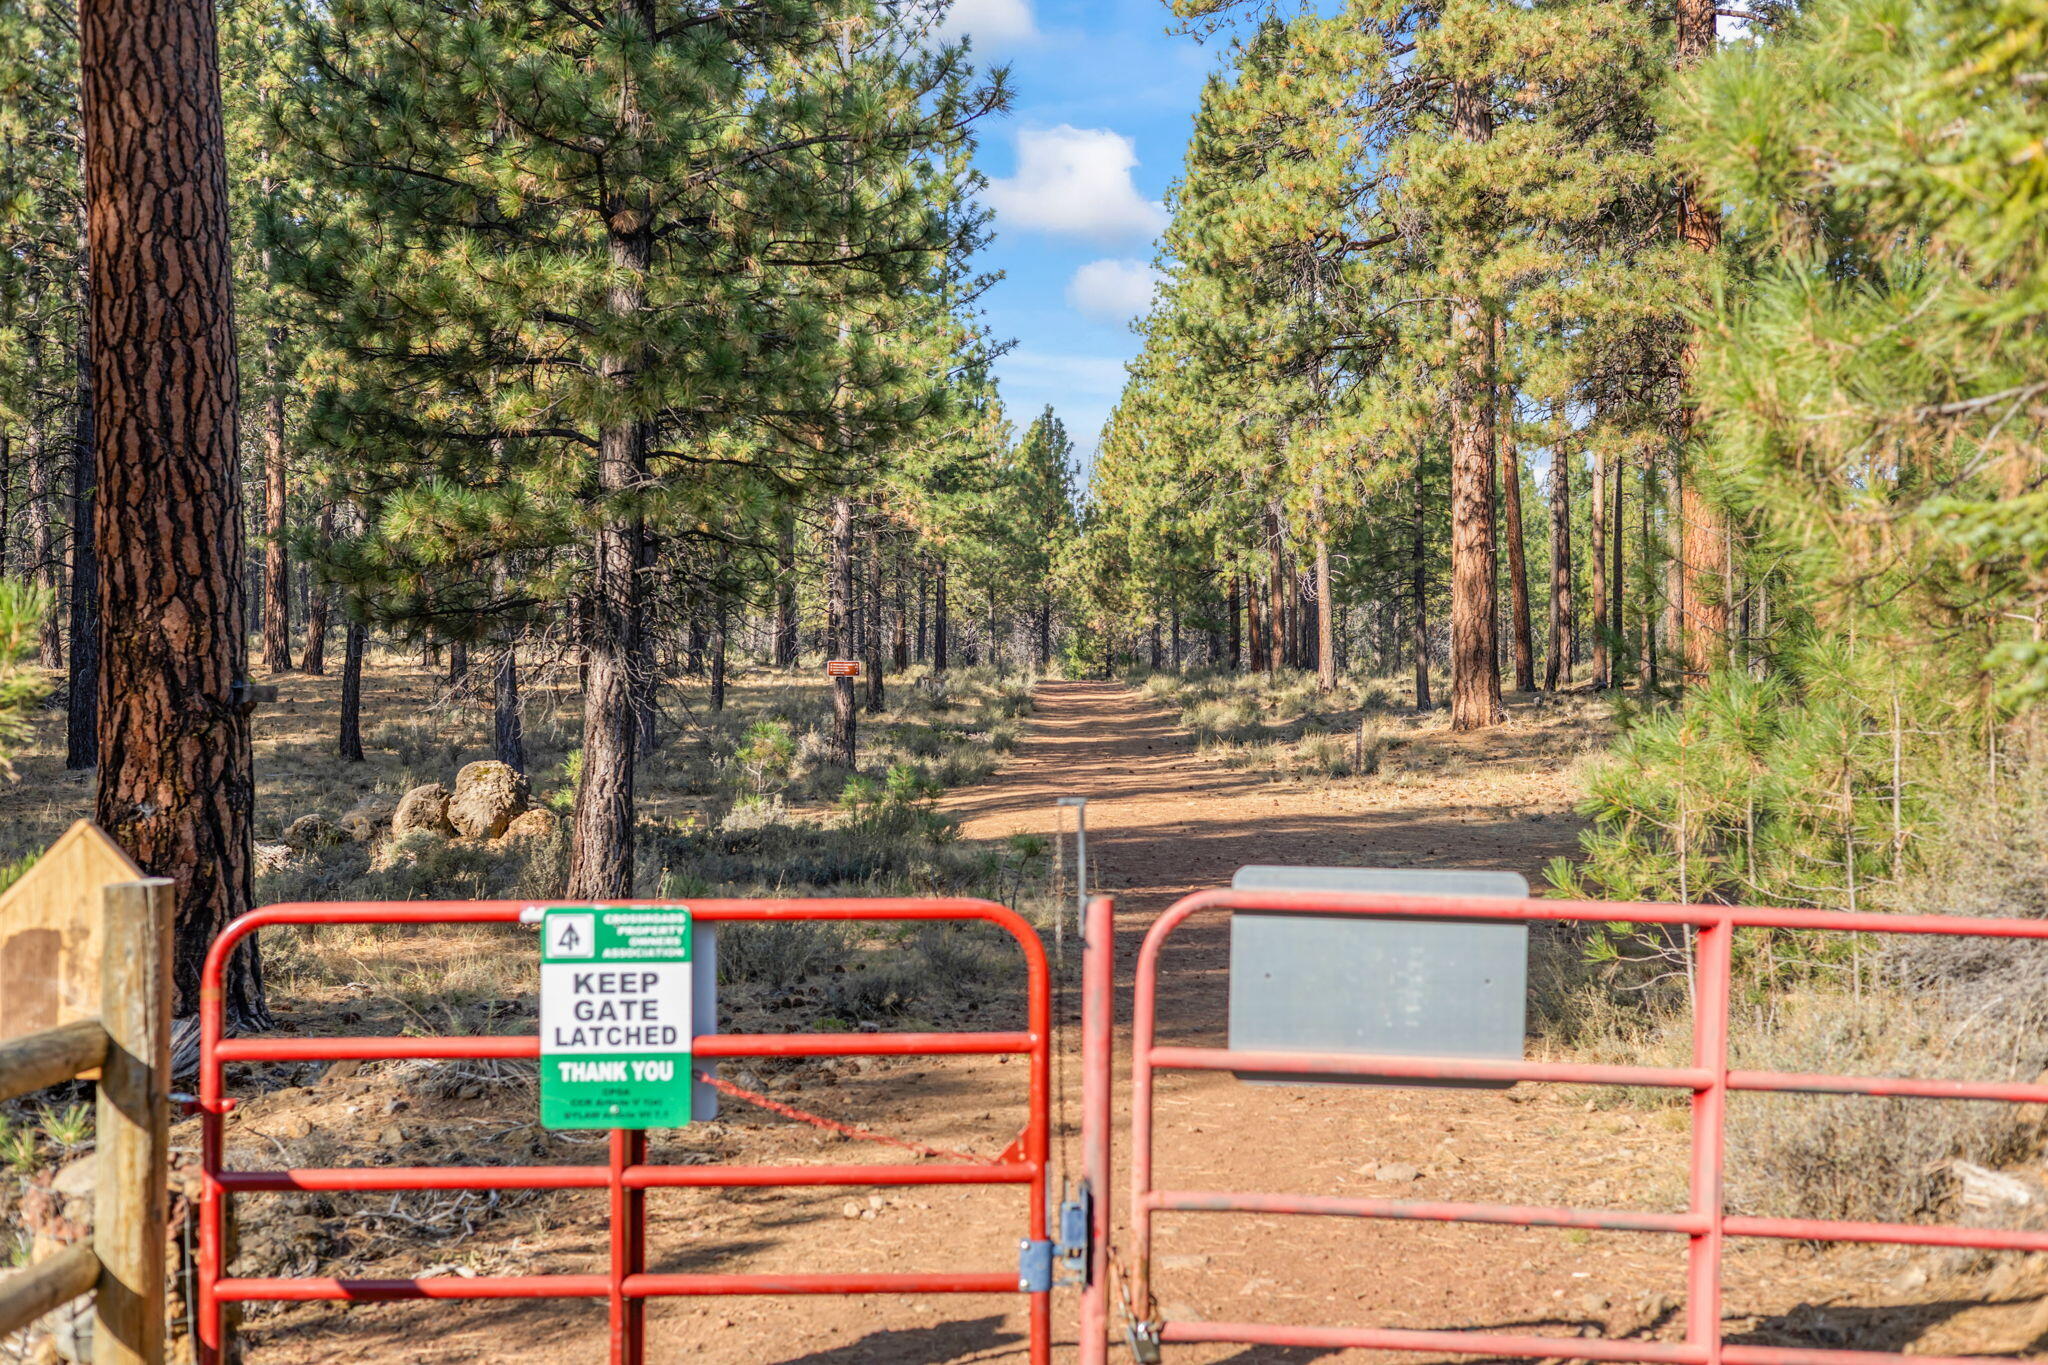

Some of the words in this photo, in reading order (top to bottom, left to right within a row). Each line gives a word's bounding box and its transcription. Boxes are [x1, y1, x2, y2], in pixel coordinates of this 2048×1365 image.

[573, 972, 659, 994] KEEP
[574, 1000, 659, 1021] GATE
[555, 1026, 677, 1046] LATCHED
[558, 1062, 628, 1083] THANK
[631, 1060, 674, 1082] YOU
